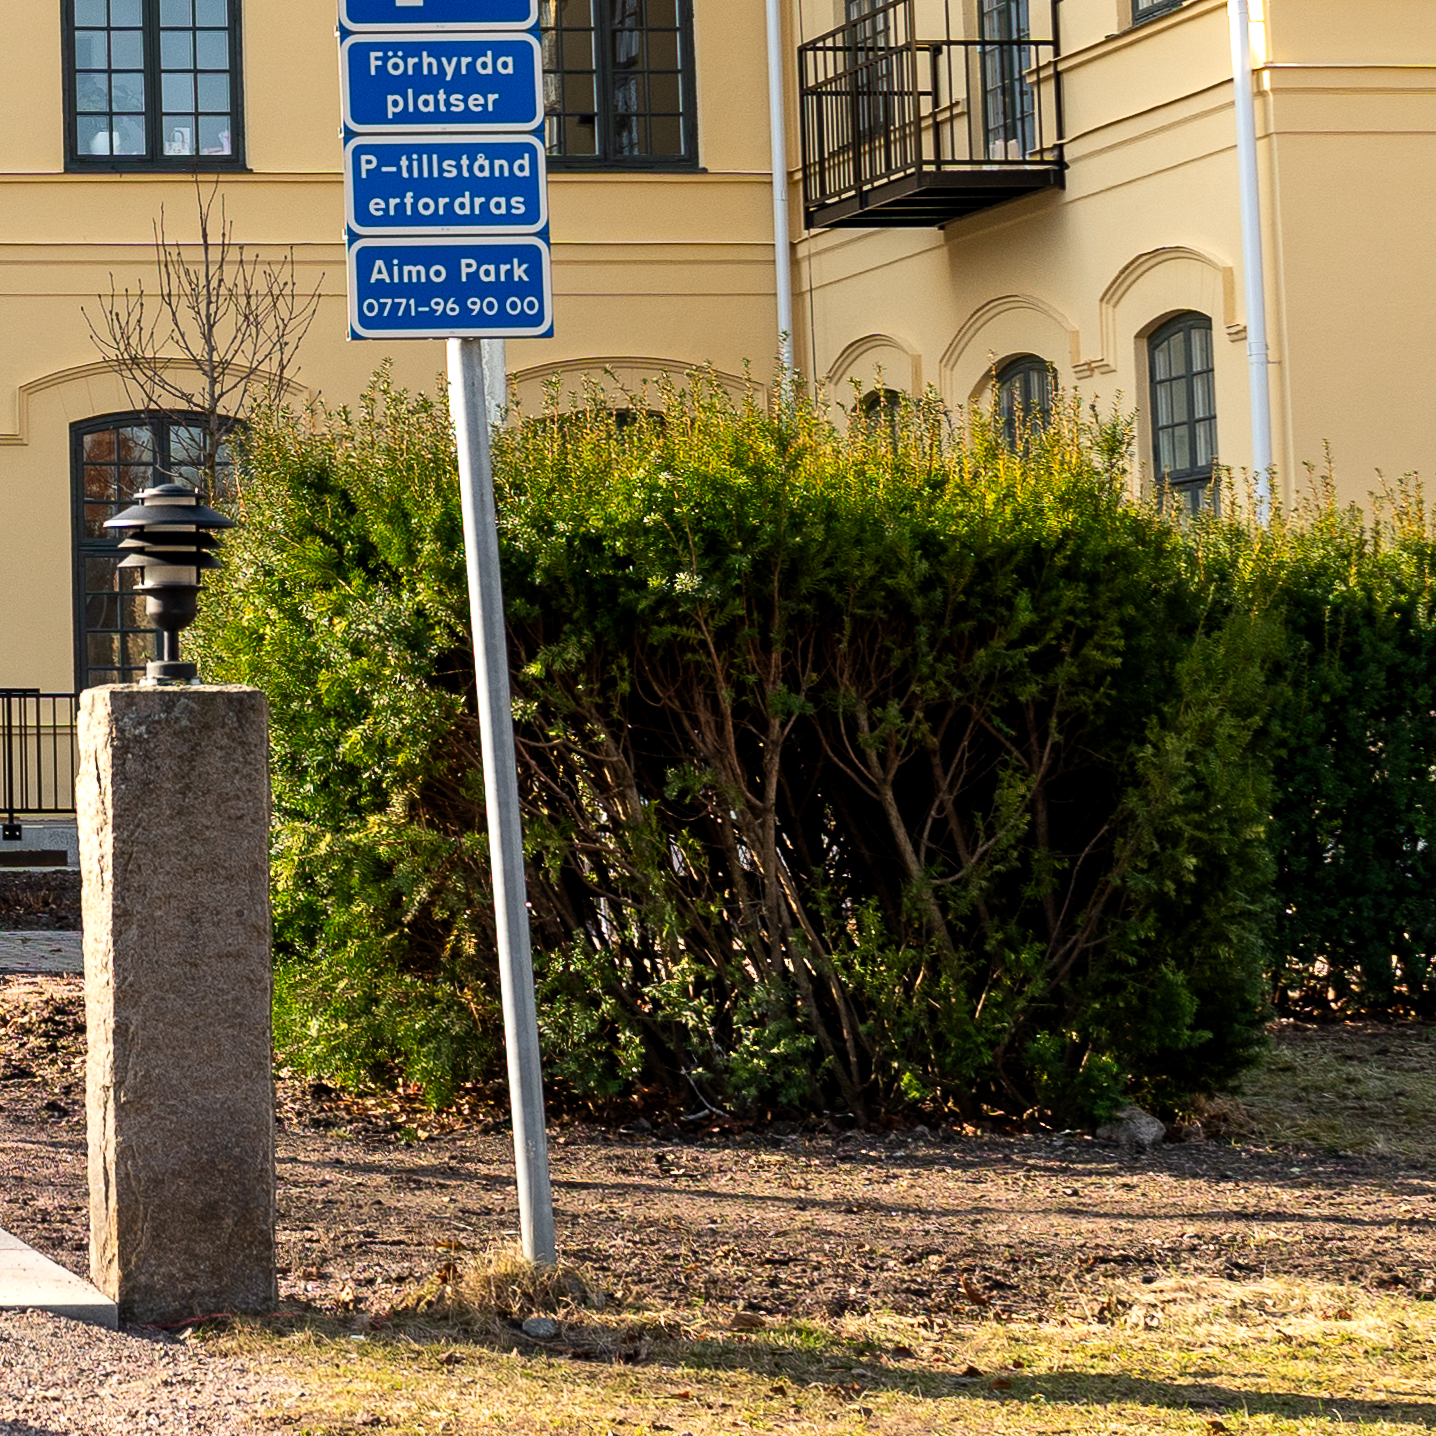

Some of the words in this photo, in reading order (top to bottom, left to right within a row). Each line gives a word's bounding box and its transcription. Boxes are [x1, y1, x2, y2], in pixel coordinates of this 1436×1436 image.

[369, 50, 514, 81] Förhyrda
[387, 88, 499, 119] platser
[360, 153, 530, 179] P-tillstånd
[368, 191, 526, 217] erfordras
[369, 259, 447, 283] Aimo
[460, 258, 529, 282] Park
[362, 297, 460, 317] 0771-96
[466, 297, 499, 316] 90
[505, 296, 539, 316] 00
